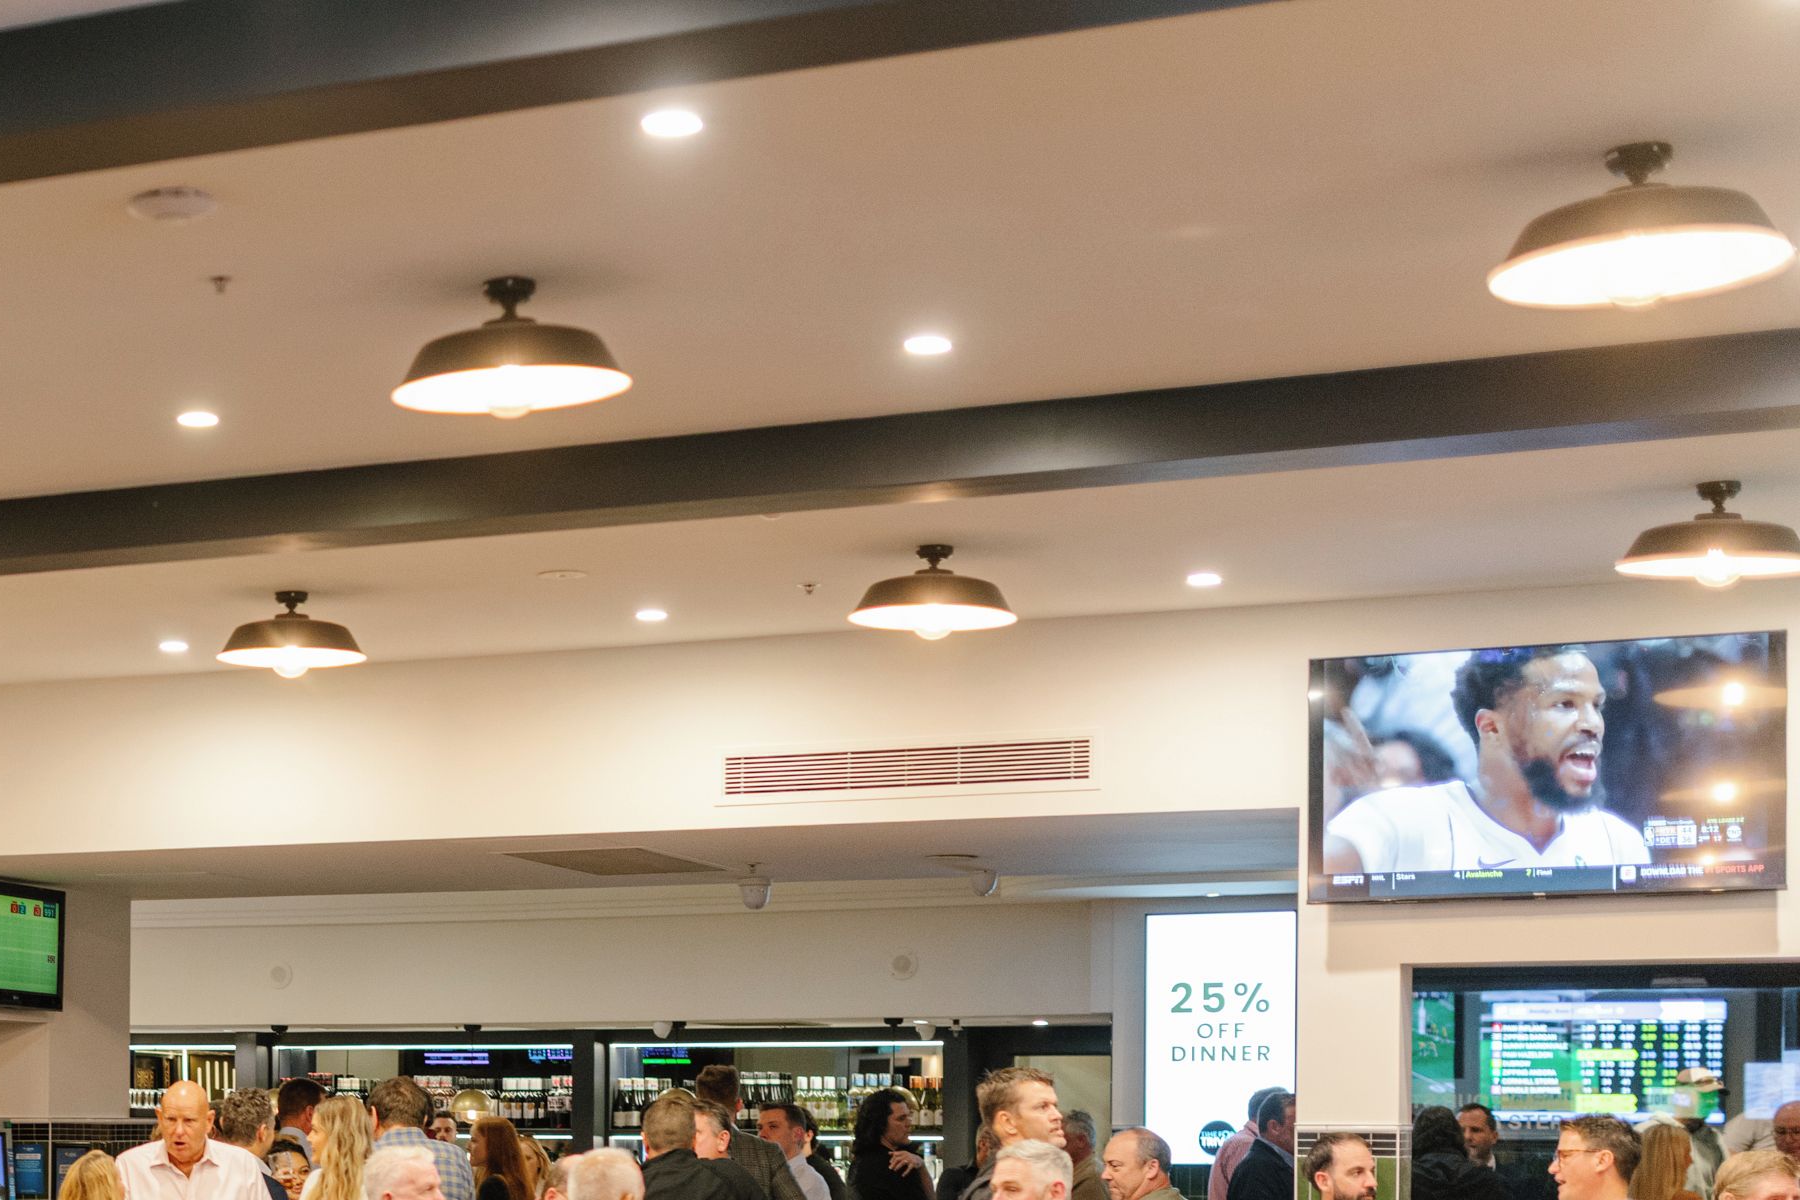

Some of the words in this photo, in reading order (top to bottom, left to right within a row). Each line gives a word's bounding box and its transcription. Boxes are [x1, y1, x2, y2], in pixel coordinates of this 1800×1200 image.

[1466, 870, 1503, 879] Avalanche
[1640, 866, 1687, 875] DOWNLOAD
[1687, 866, 1704, 875] THE
[1715, 865, 1746, 873] SPORTS
[1748, 864, 1765, 873] APP
[1332, 876, 1364, 885] ESPN
[1171, 982, 1270, 1013] 25%
[1197, 1023, 1245, 1038] OFF
[1171, 1045, 1271, 1061] DINNER
[1200, 1136, 1225, 1148] TRIV
